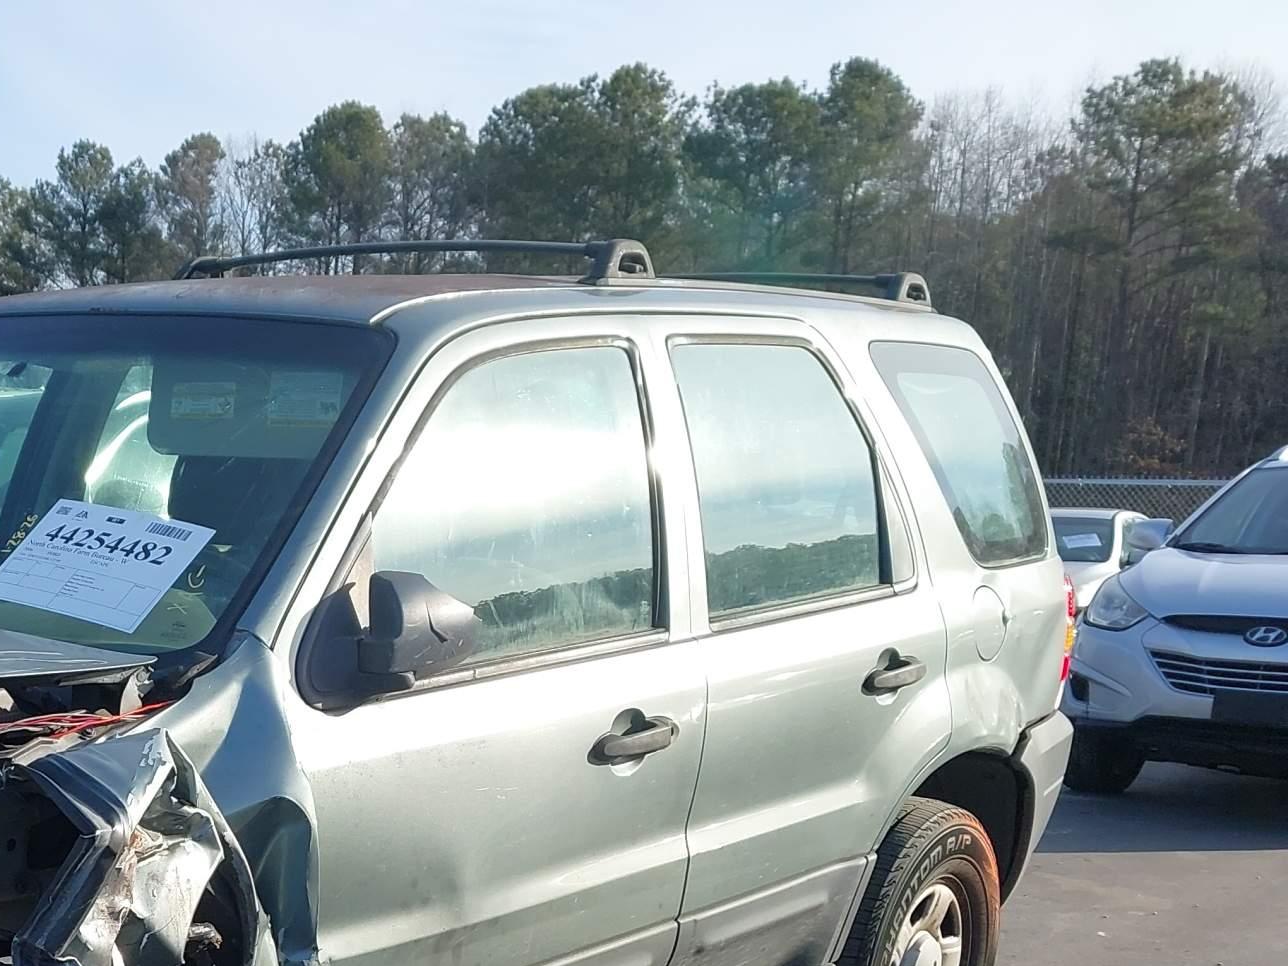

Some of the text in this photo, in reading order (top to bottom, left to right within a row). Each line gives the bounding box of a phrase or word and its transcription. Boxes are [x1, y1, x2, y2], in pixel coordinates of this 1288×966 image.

[44, 523, 173, 566] 44254482
[46, 542, 73, 554] Carolina
[72, 548, 91, 558] Farm
[91, 552, 115, 563] Bureau
[946, 833, 972, 855] A/P
